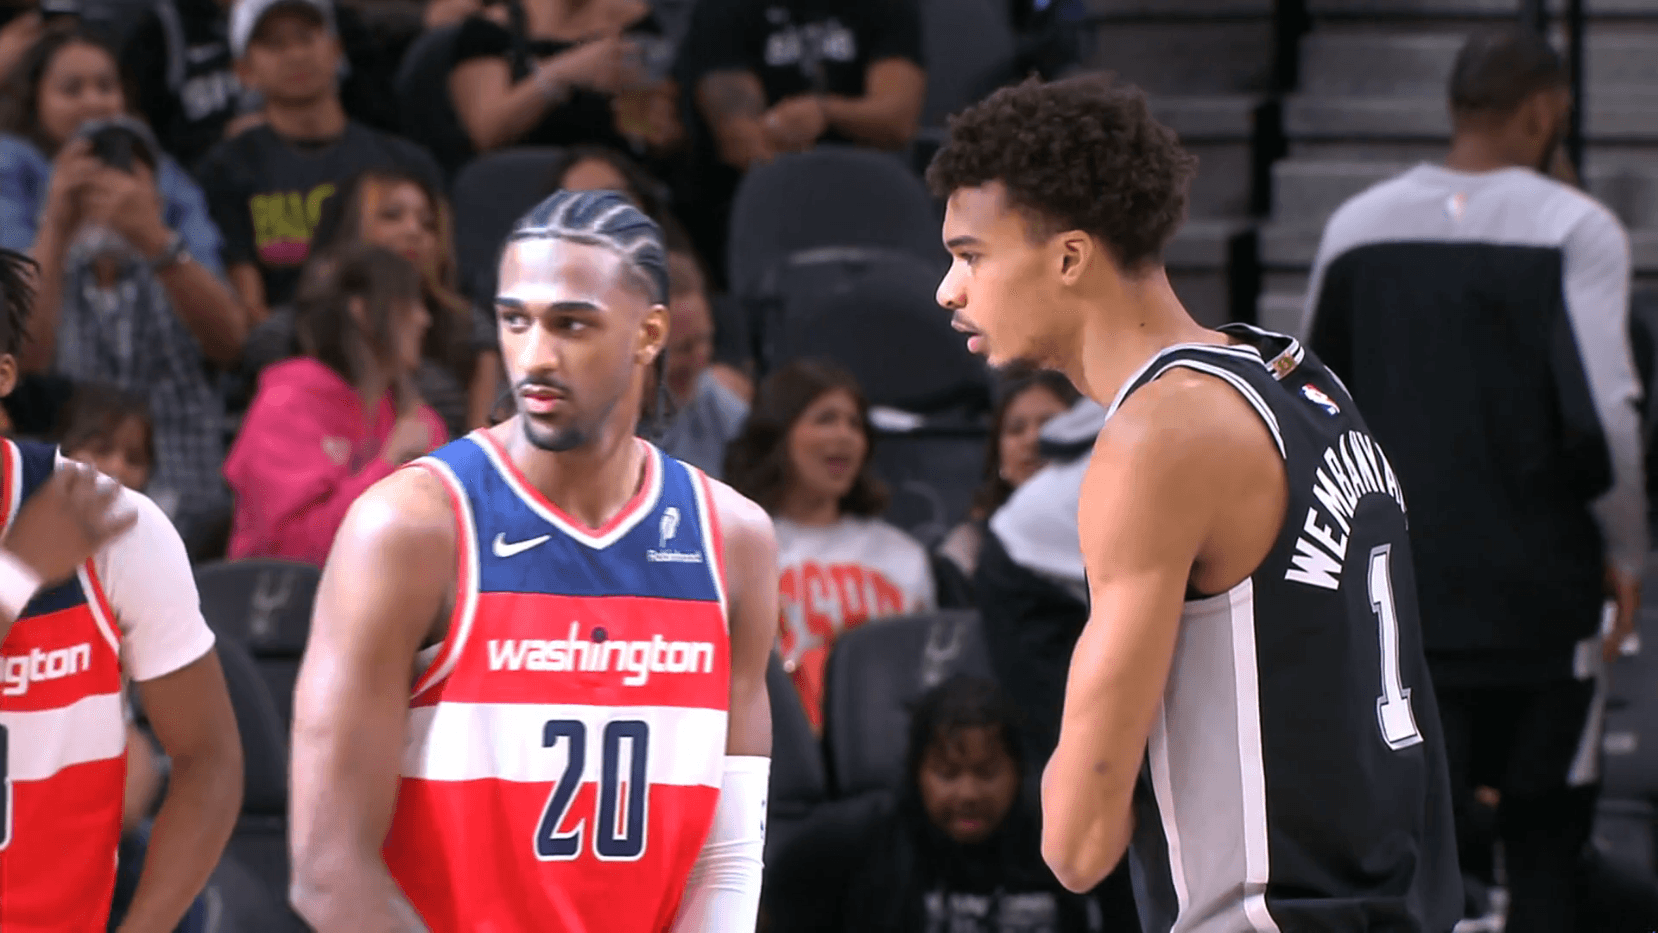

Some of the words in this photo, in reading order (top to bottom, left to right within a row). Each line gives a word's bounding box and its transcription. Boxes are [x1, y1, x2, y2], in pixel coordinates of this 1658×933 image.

[1284, 429, 1408, 590] WEMBANYA
[0, 642, 91, 696] gton
[486, 620, 715, 687] washington
[1368, 543, 1423, 750] 1
[533, 718, 651, 863] 20
